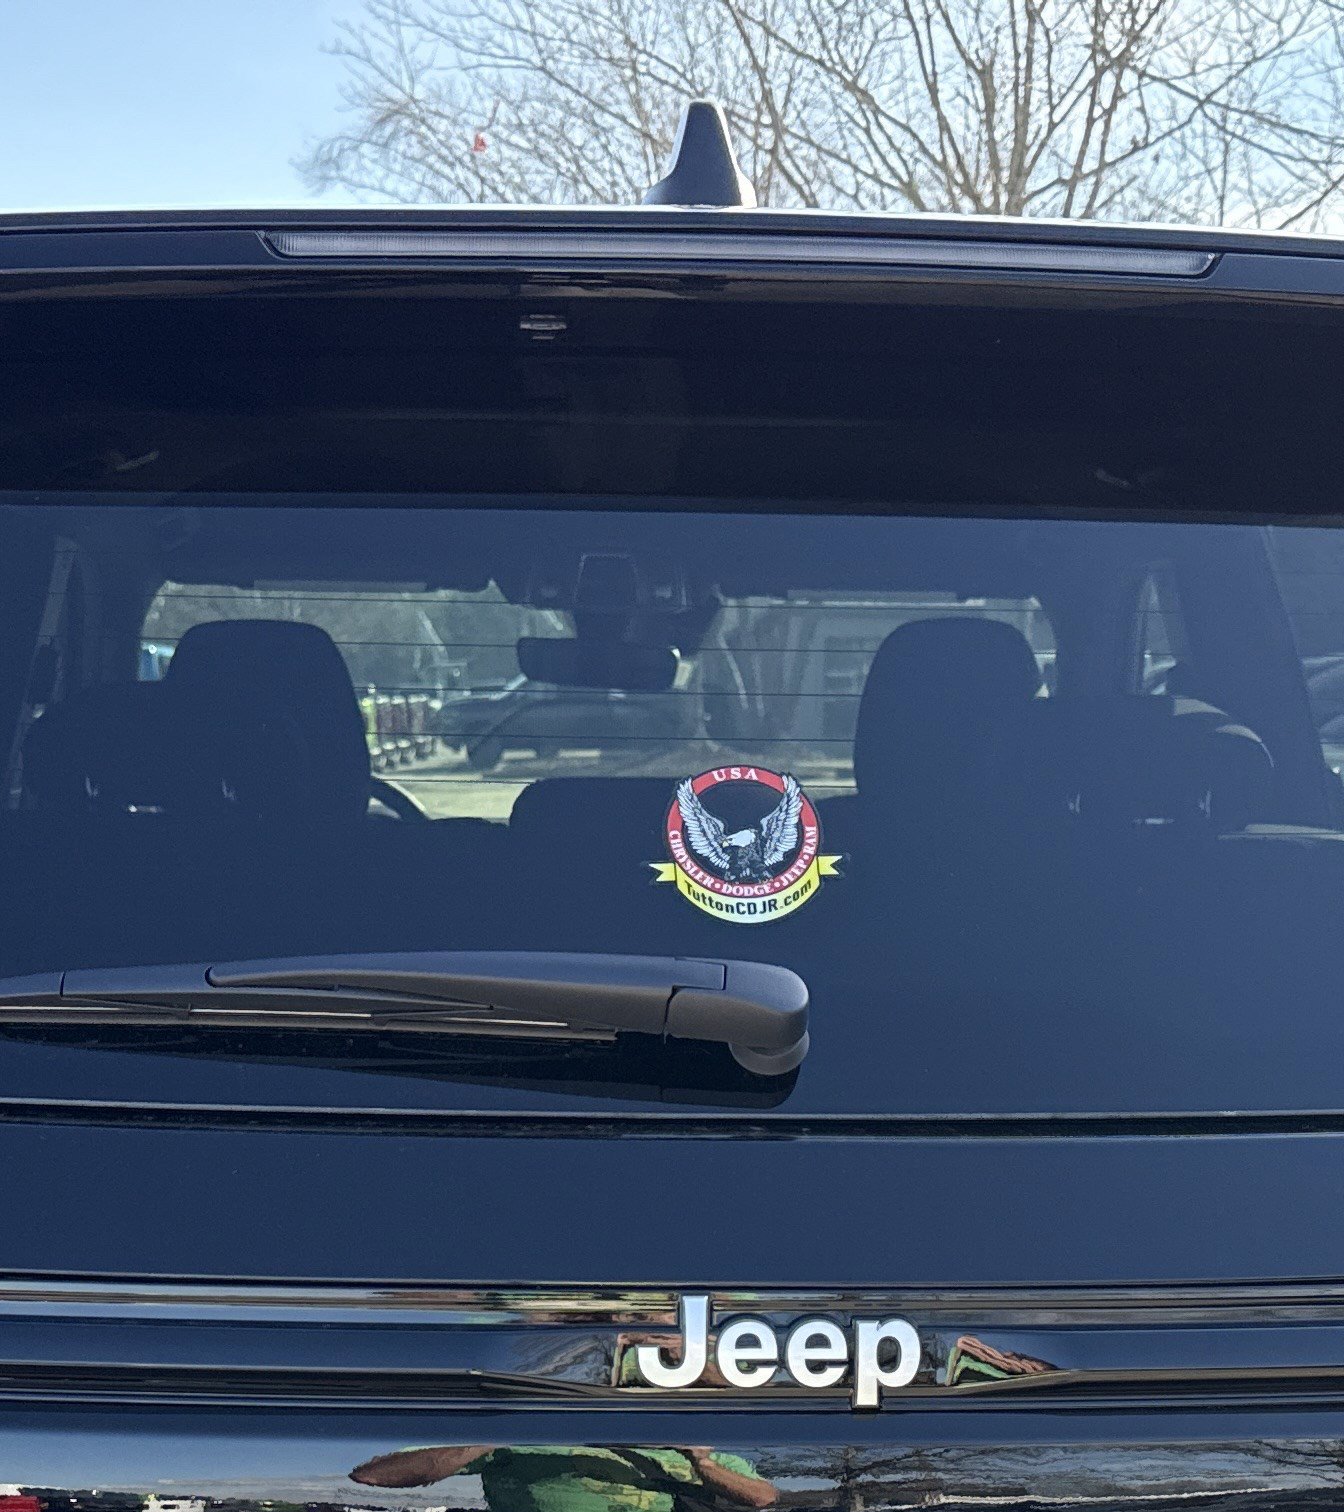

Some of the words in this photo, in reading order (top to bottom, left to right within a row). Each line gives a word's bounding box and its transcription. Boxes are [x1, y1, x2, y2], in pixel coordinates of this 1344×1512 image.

[711, 767, 759, 782] USA
[721, 882, 775, 897] DODGE
[778, 860, 809, 888] JEEP
[803, 826, 818, 855] RAM
[684, 878, 813, 916] TuttonCDJR.com
[637, 1294, 922, 1409] Jeep
